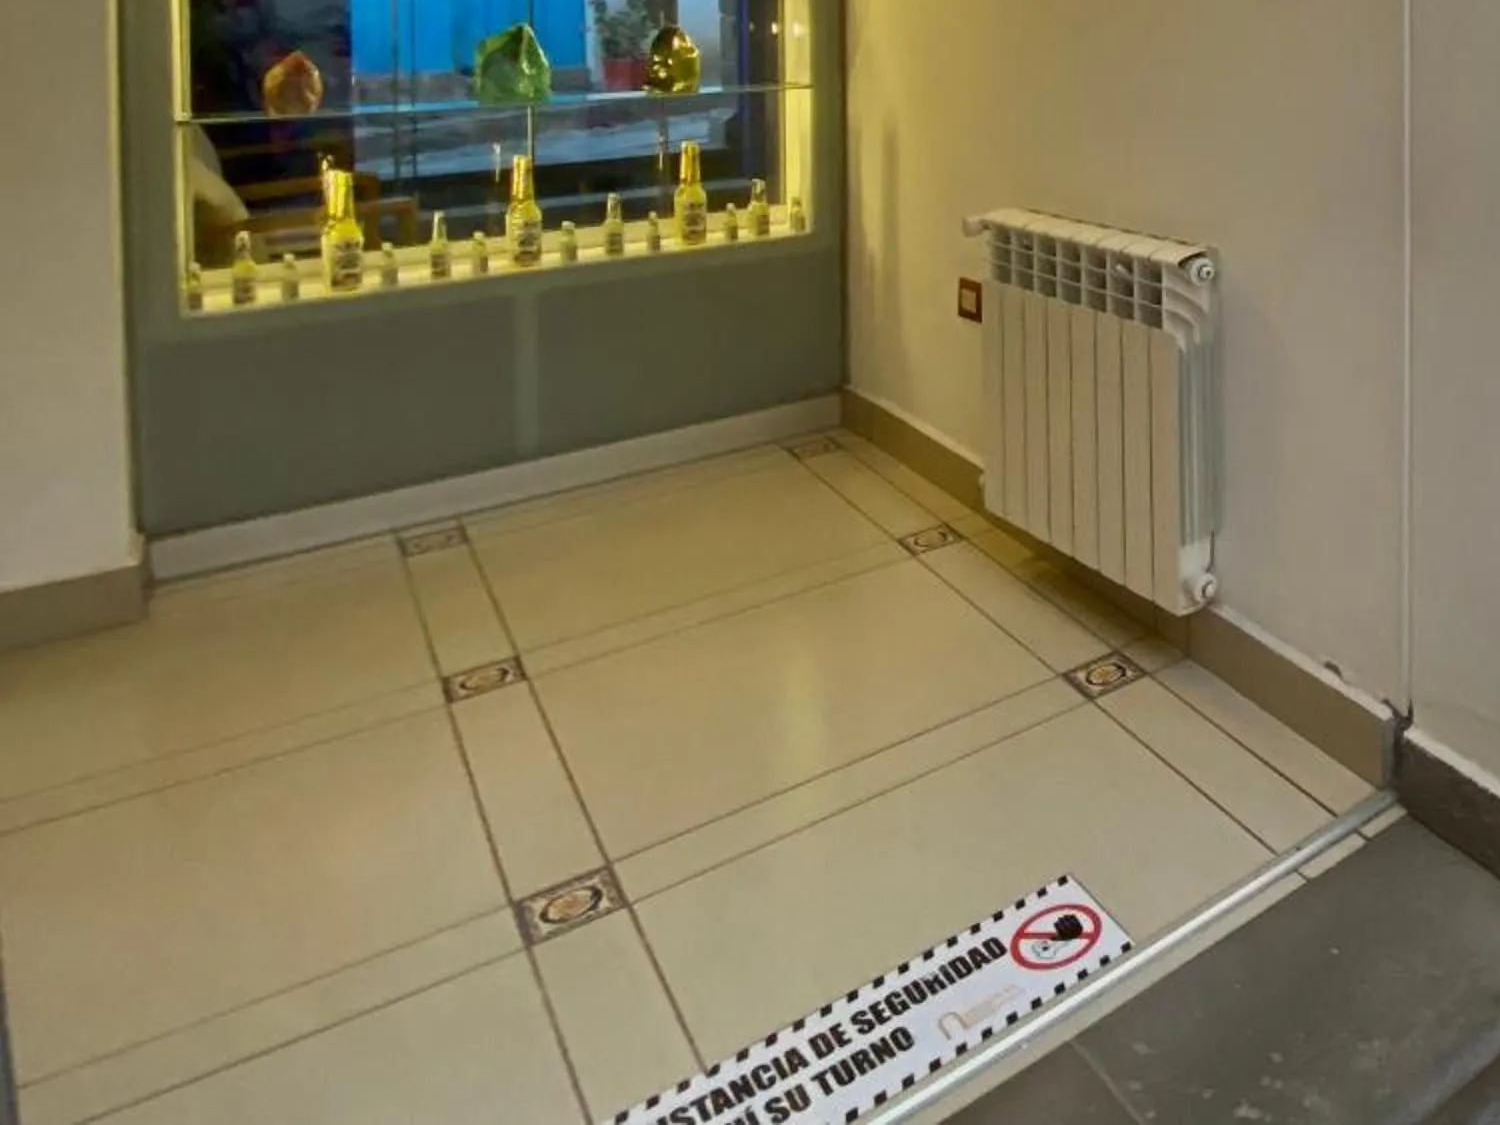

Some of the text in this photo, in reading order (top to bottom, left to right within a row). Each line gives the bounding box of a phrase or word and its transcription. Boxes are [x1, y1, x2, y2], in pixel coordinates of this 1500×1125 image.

[764, 1026, 915, 1125] SU TURNO
[808, 1022, 852, 1061] DE
